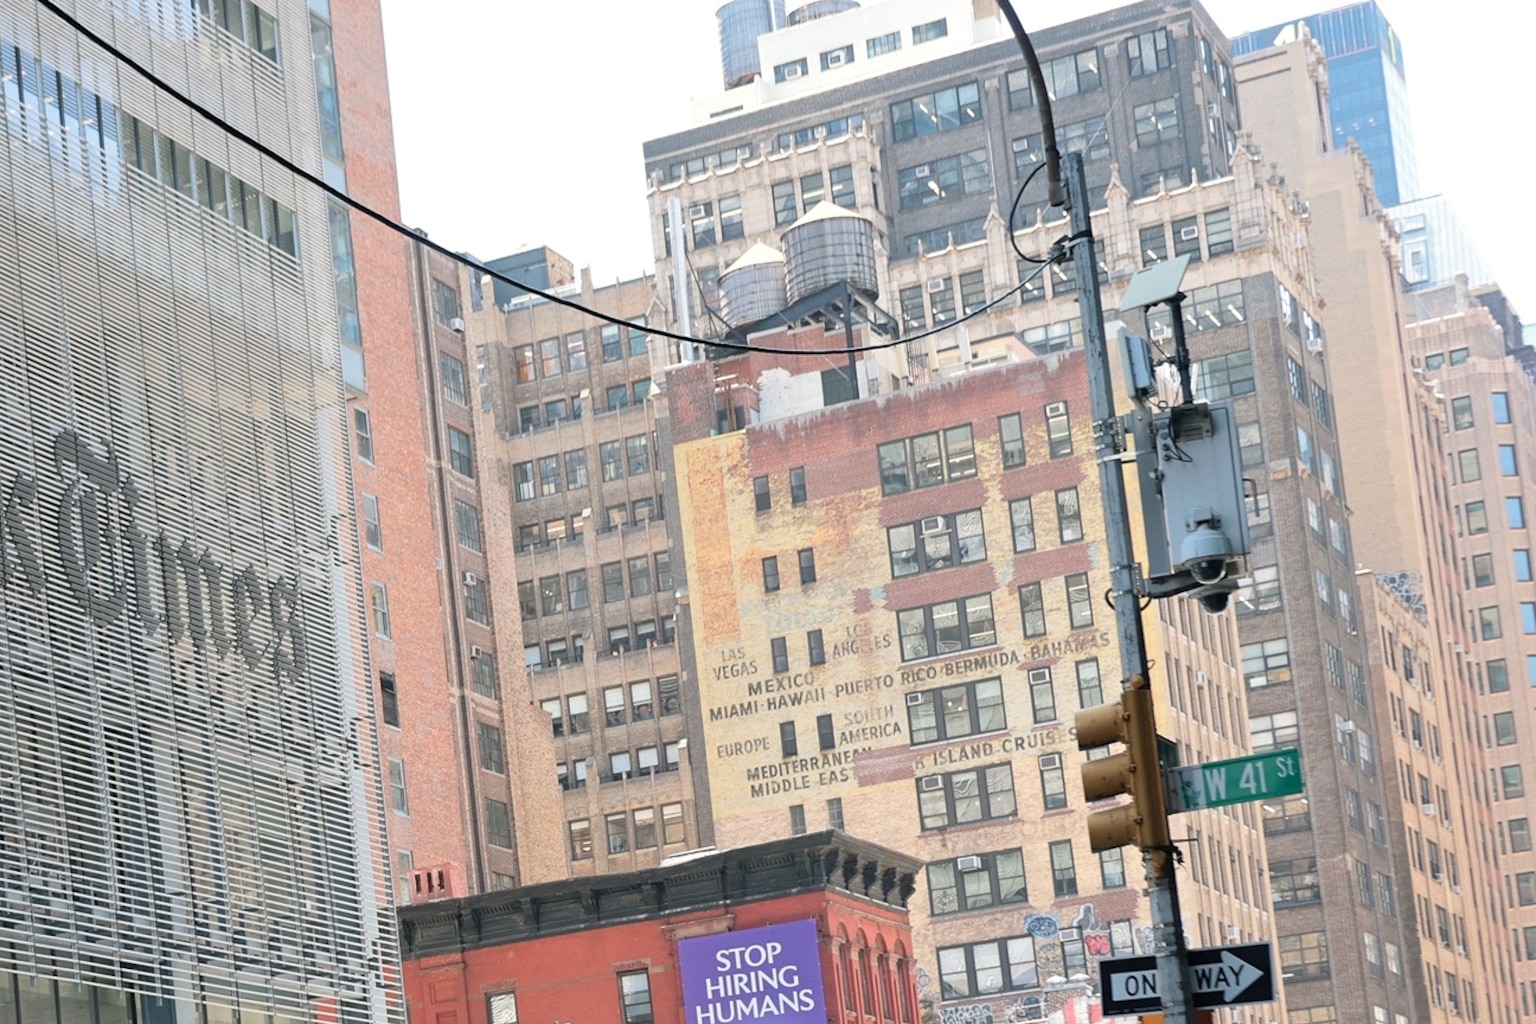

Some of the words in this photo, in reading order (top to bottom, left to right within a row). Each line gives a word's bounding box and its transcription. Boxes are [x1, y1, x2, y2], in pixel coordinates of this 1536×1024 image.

[52, 426, 306, 686] Times
[721, 647, 746, 662] LAS
[709, 701, 758, 722] MIAMI
[767, 687, 825, 711] HAWAII
[835, 674, 894, 698] PUERTO
[901, 666, 937, 686] RICO
[944, 651, 1020, 677] BERMUDA
[1030, 632, 1111, 660] BAHAMAS
[713, 660, 758, 681] VEGAS
[748, 672, 815, 697] MEXICO
[843, 705, 895, 726] SOUTH
[838, 722, 902, 746] AMERICA
[717, 736, 770, 759] EUROPE
[933, 743, 993, 766] ISLAND
[751, 775, 811, 798] MIDDLE
[1205, 767, 1227, 800] W
[1239, 761, 1268, 795] 41
[1275, 756, 1295, 778] St
[715, 941, 782, 972] STOP
[705, 965, 800, 1001] HIRING
[1125, 974, 1157, 996] ON
[1195, 964, 1245, 990] WAY
